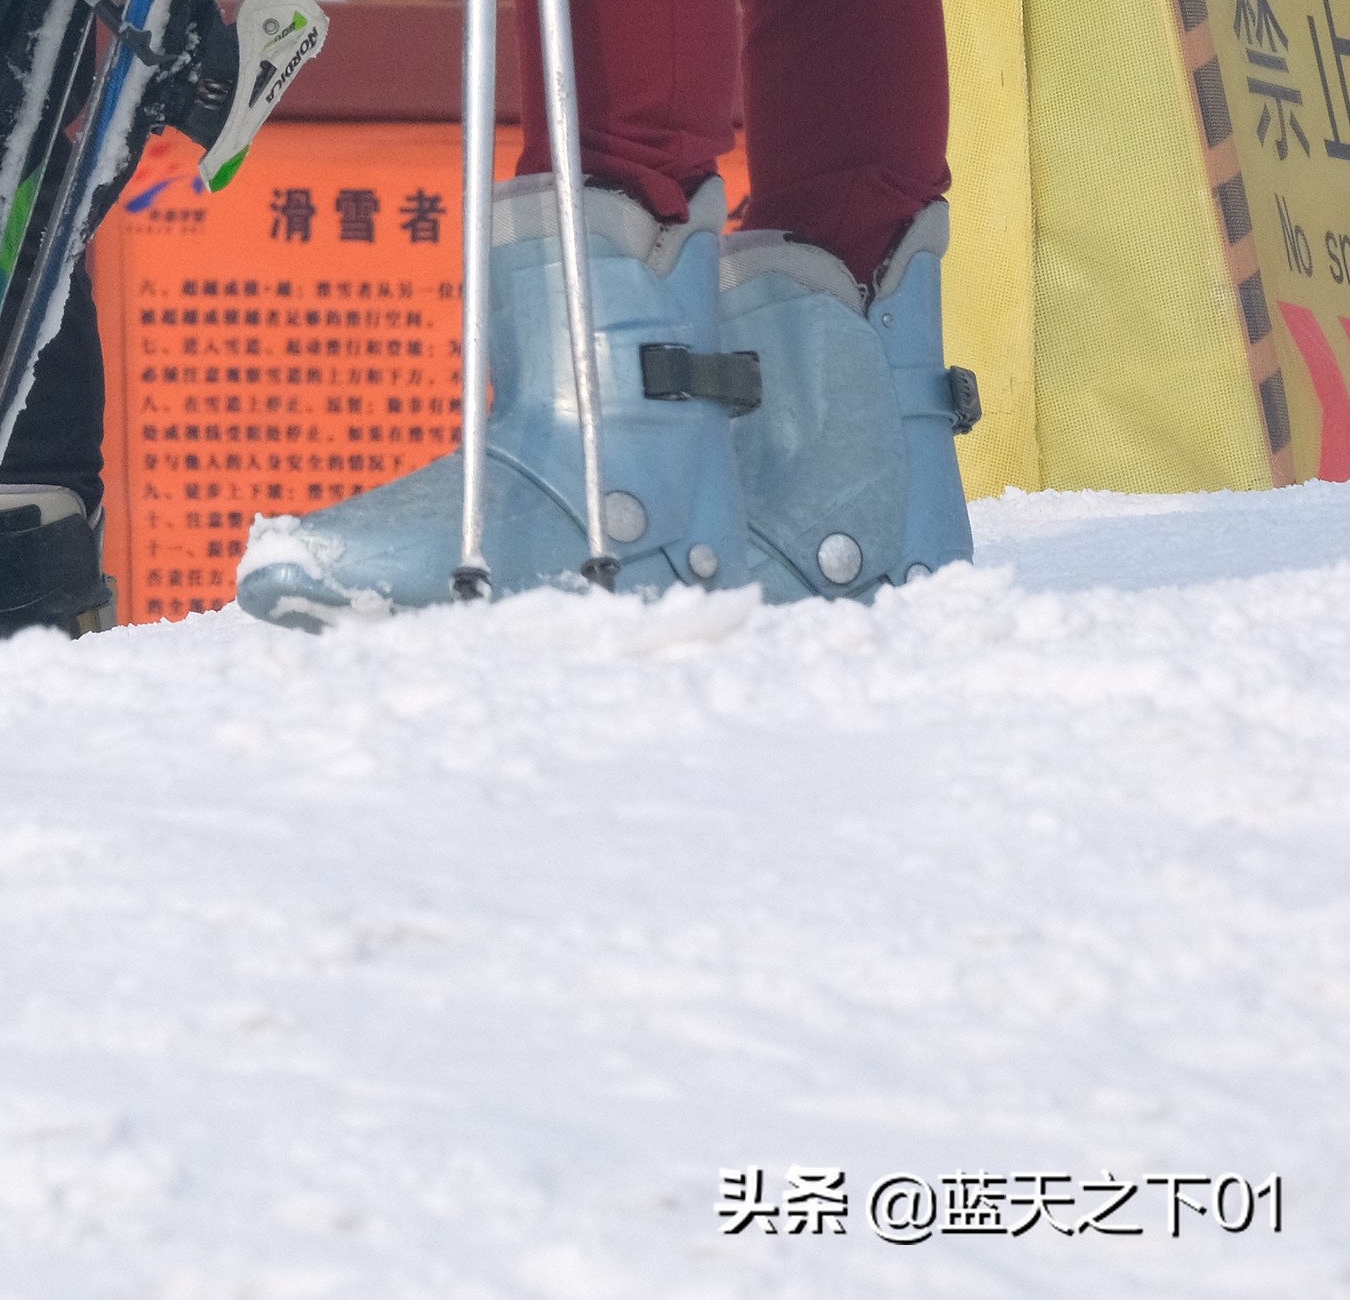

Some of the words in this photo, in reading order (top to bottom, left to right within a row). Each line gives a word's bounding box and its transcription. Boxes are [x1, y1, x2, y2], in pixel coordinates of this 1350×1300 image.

[266, 26, 319, 104] NORDICA
[270, 187, 447, 245] 滑雪者
